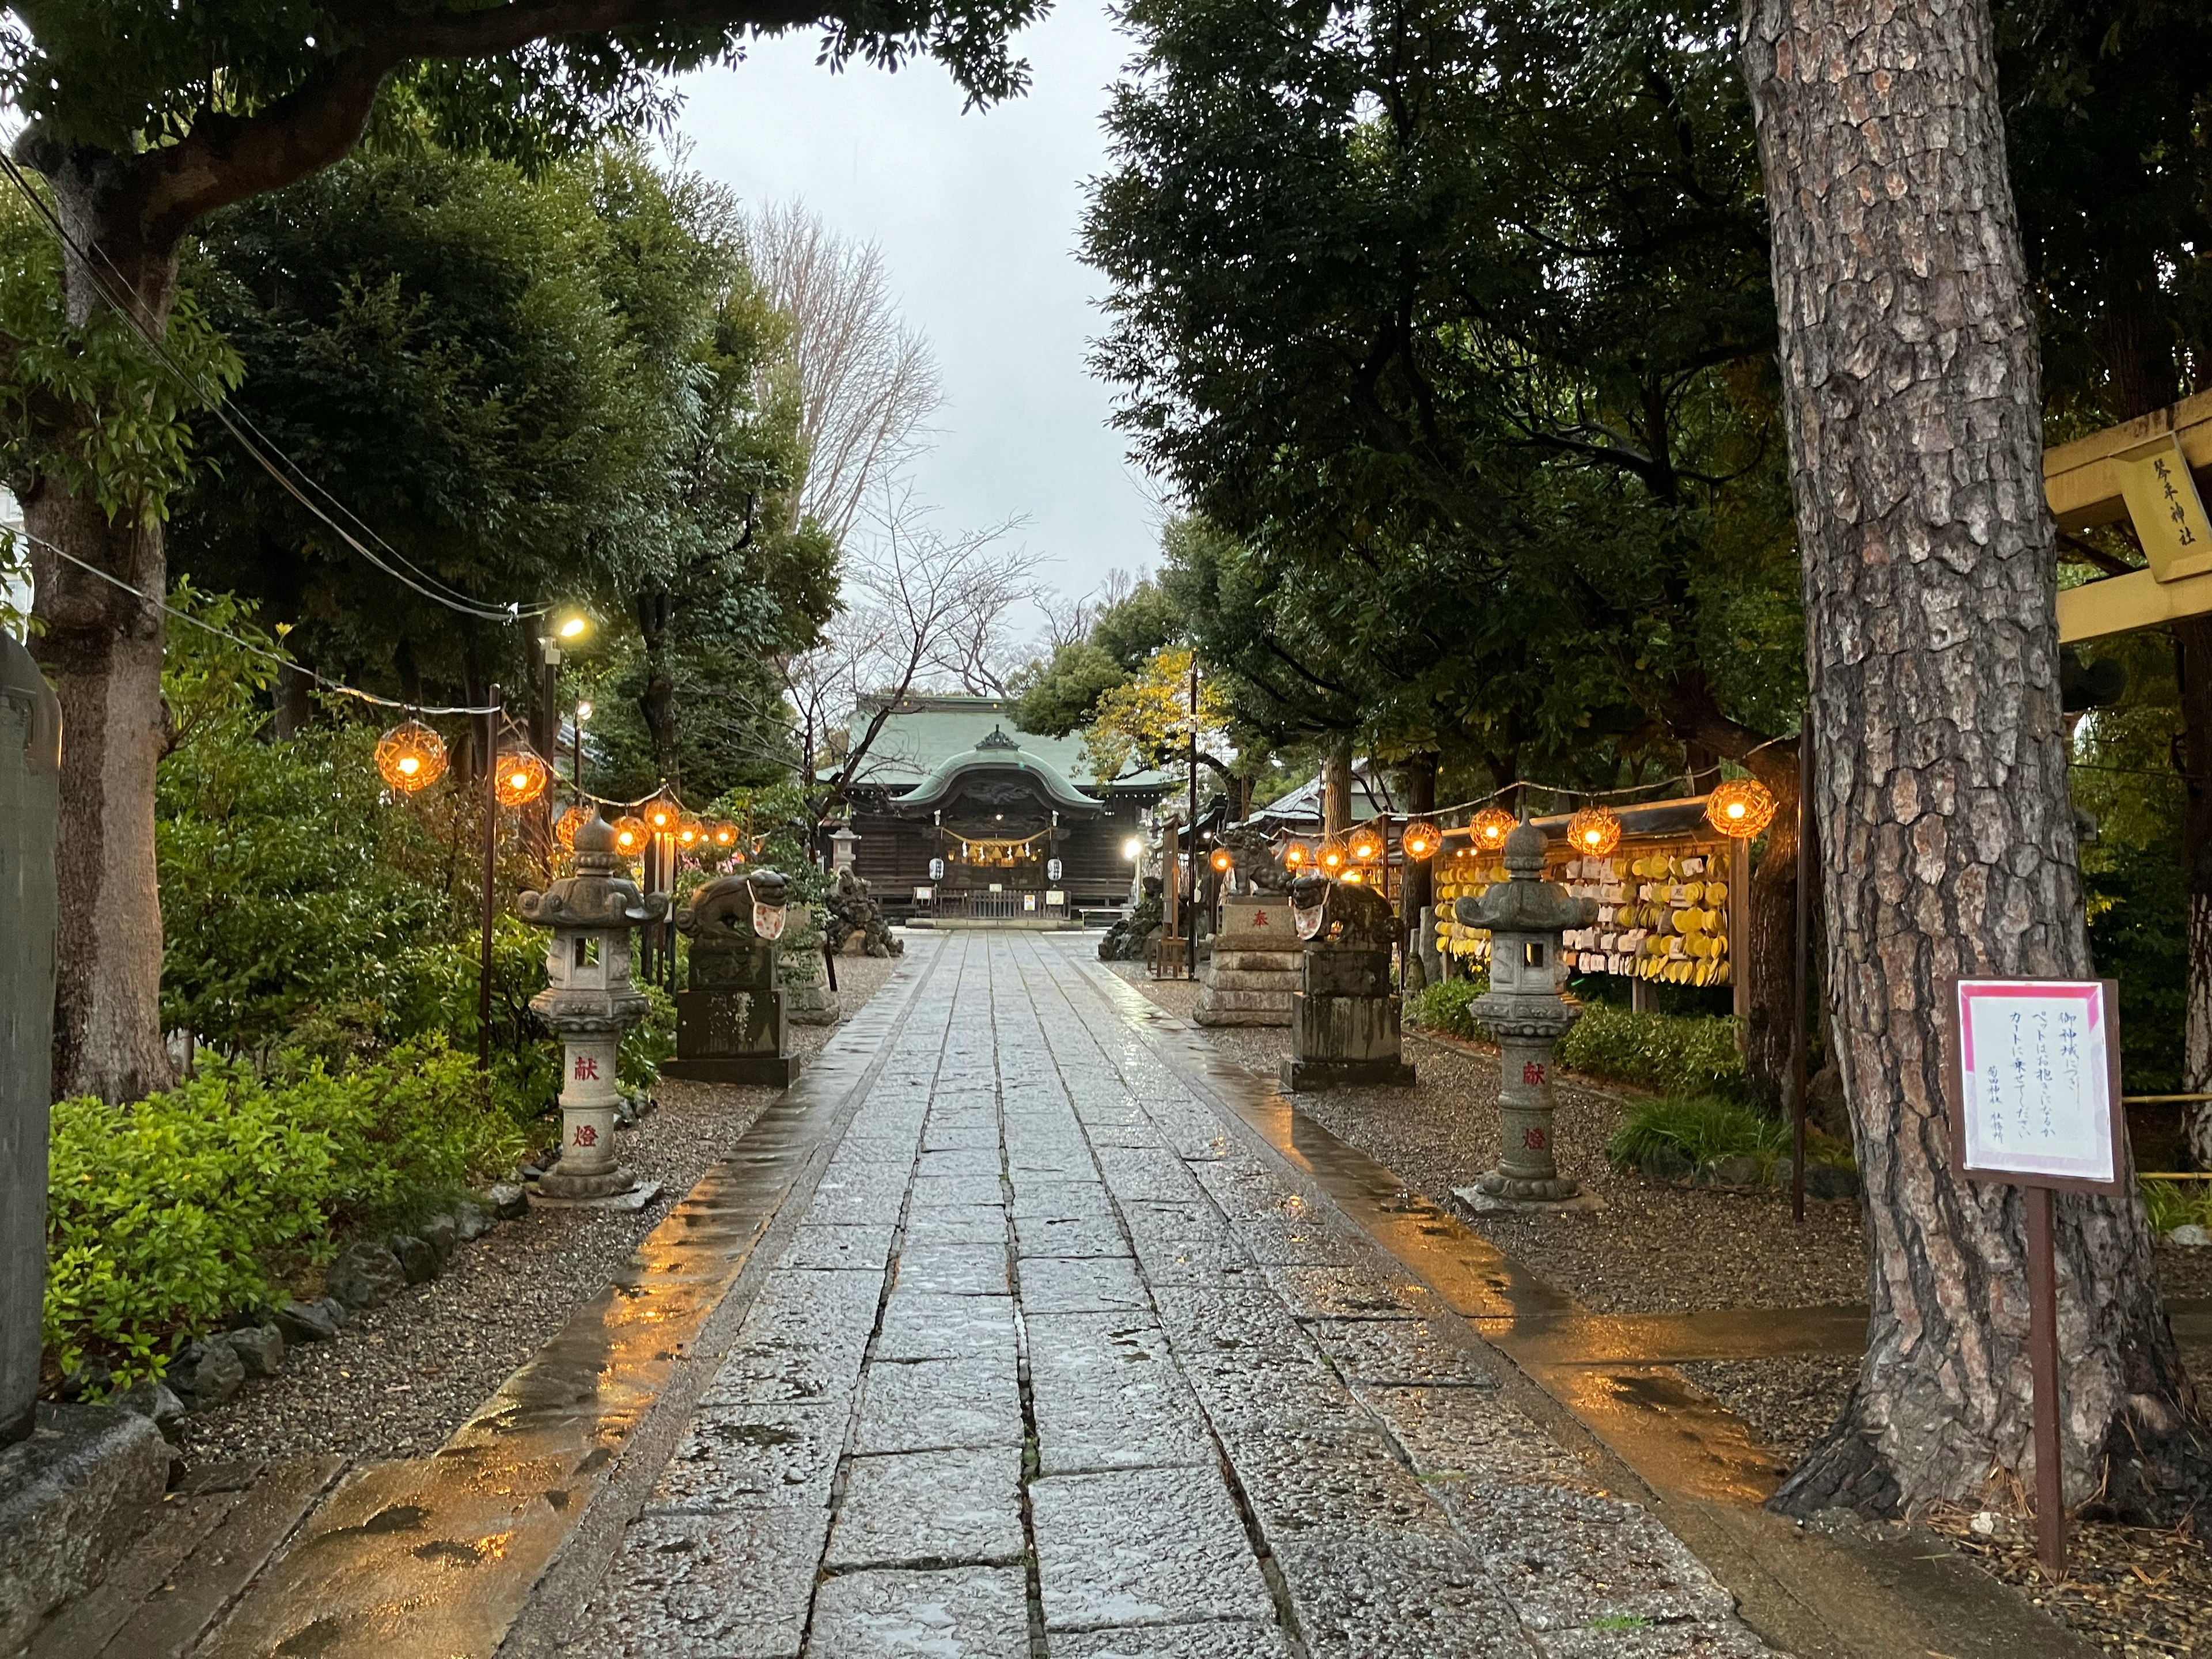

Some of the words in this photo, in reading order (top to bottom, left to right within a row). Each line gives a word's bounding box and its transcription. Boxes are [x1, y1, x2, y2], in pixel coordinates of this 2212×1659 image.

[2154, 458, 2196, 546] 琴平神社
[1252, 910, 1269, 928] 奉
[2009, 1012, 2031, 1138] カートに乗せてください
